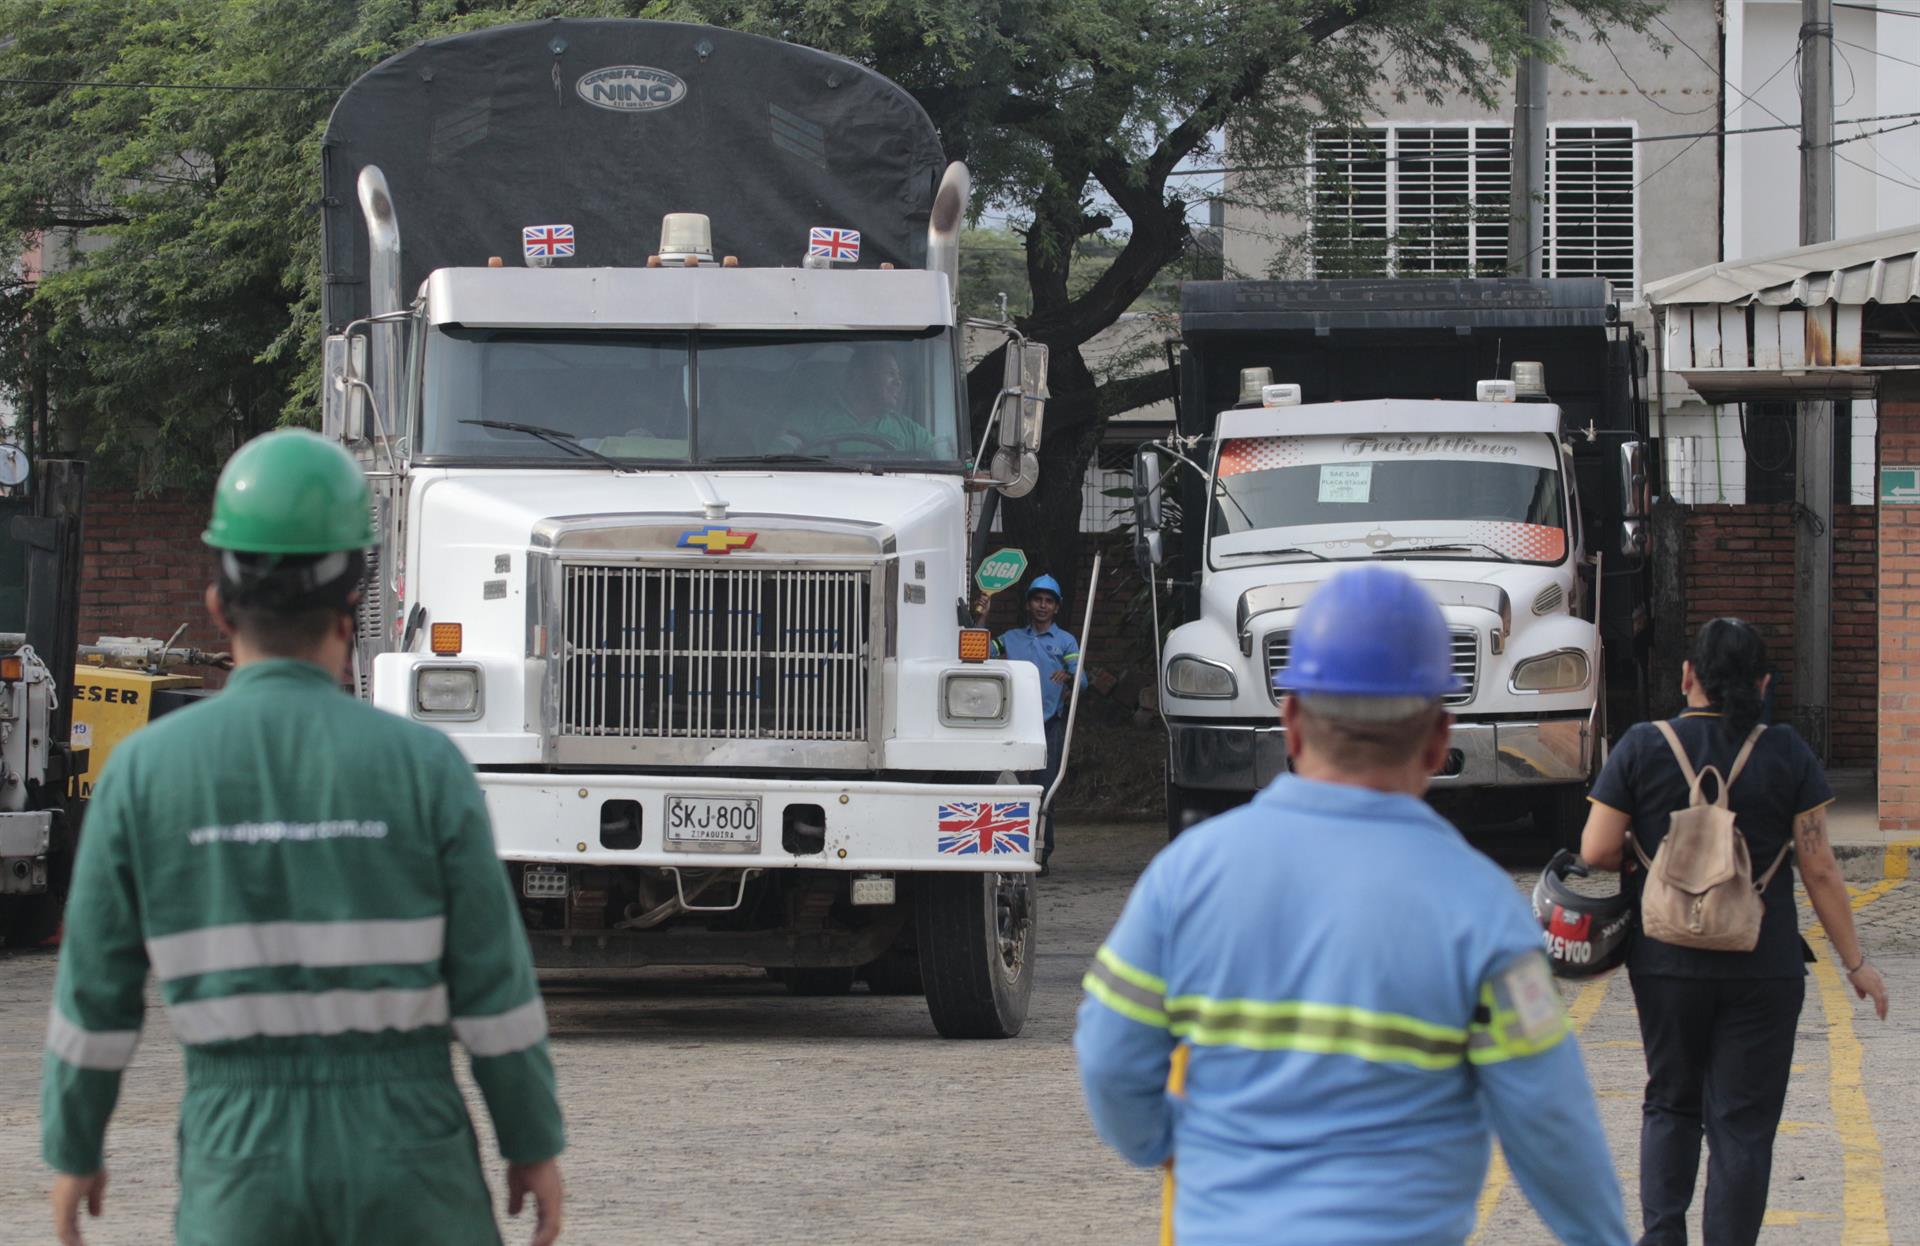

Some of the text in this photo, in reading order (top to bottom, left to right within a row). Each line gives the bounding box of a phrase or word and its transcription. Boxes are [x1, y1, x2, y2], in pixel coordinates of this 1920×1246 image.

[592, 83, 672, 102] NINO
[1342, 434, 1518, 456] Freightliner
[982, 561, 1020, 579] SIGA
[691, 831, 735, 839] ZIPAQUIRA
